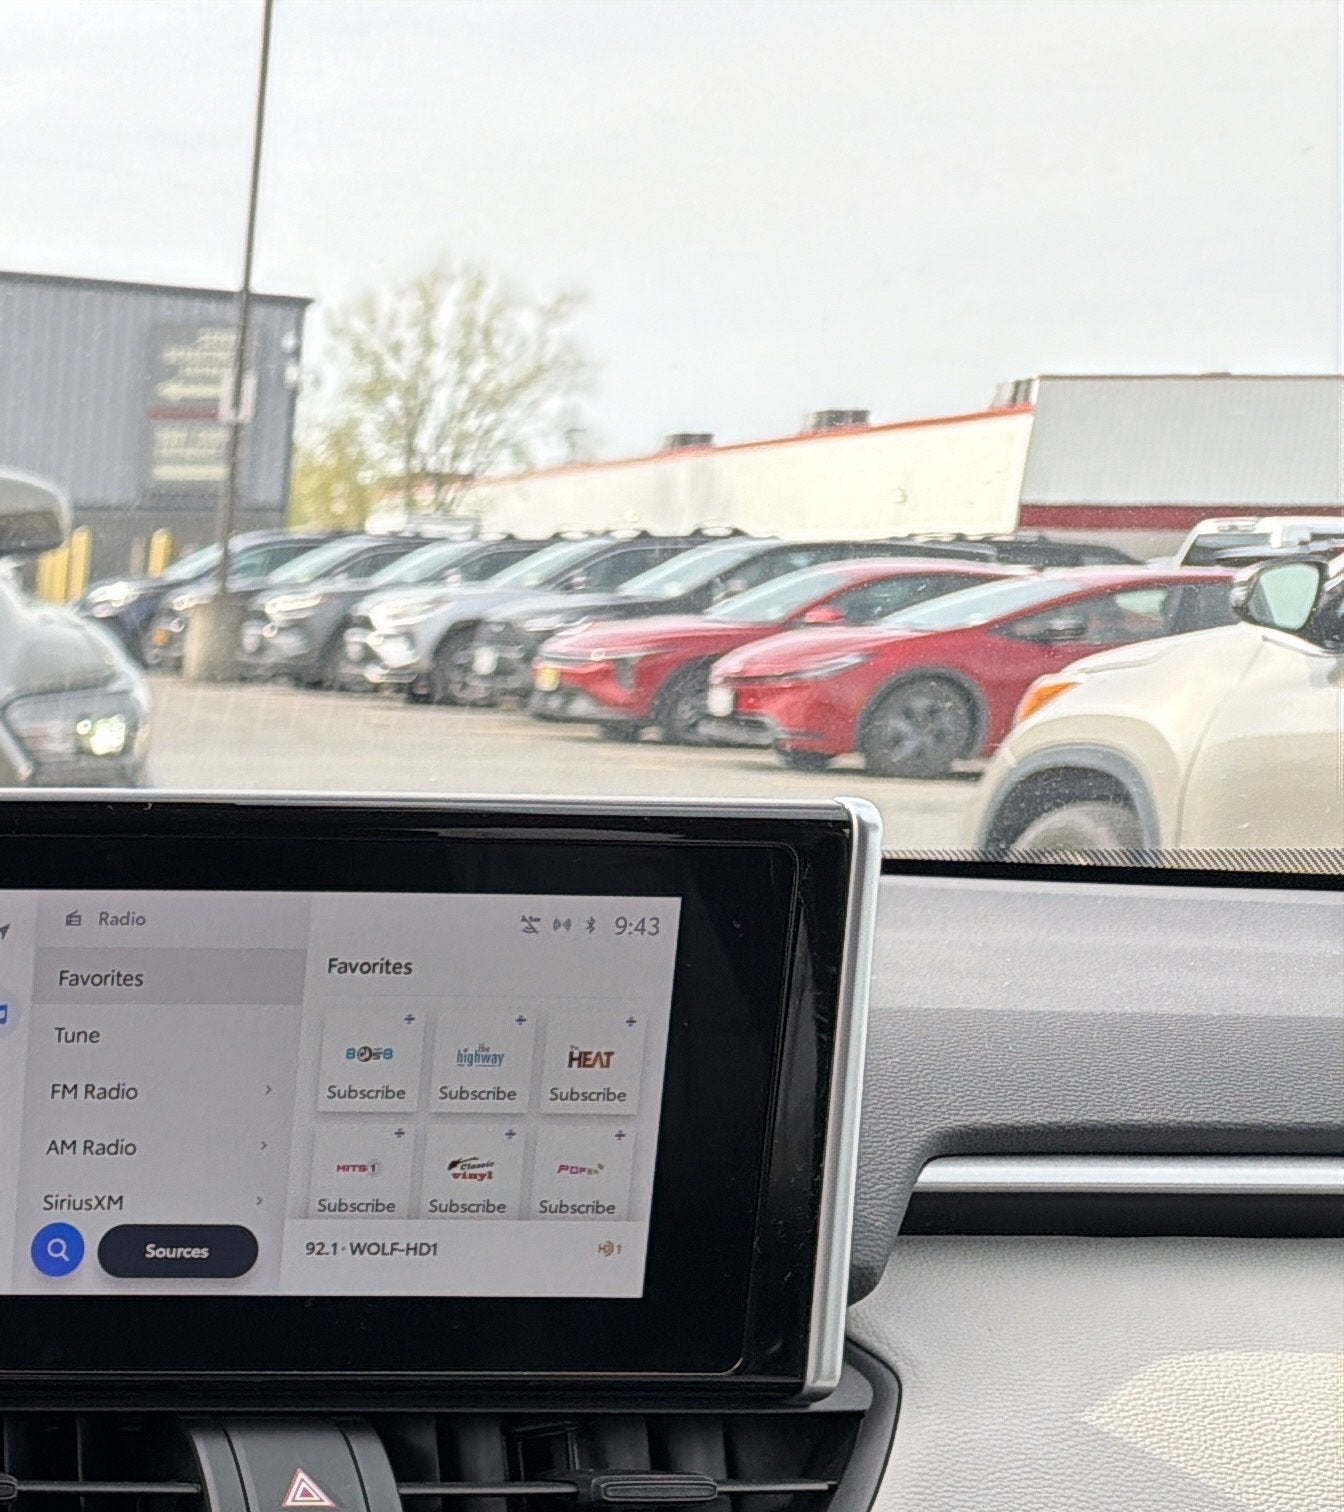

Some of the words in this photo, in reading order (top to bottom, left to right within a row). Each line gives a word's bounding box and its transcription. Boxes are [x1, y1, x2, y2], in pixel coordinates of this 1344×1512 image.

[98, 911, 146, 928] Radio
[615, 916, 661, 937] 9:43
[328, 956, 413, 976] Favorites
[58, 969, 144, 987] Favorites
[55, 1027, 100, 1044] Tune
[456, 1048, 504, 1067] highway
[567, 1050, 615, 1069] HEAT
[51, 1082, 77, 1101] FM
[84, 1082, 138, 1101] Radio
[326, 1085, 406, 1100] Subscribe
[439, 1086, 517, 1101] Subscribe
[549, 1087, 627, 1102] Subscribe
[46, 1138, 76, 1157] AM
[82, 1138, 137, 1157] Radio
[43, 1193, 124, 1212] SiriusXM
[317, 1198, 396, 1214] Subscribe
[428, 1199, 507, 1214] Subscribe
[539, 1200, 616, 1215] Subscribe
[145, 1243, 209, 1260] Sources
[349, 1242, 438, 1256] WOLF-HD1
